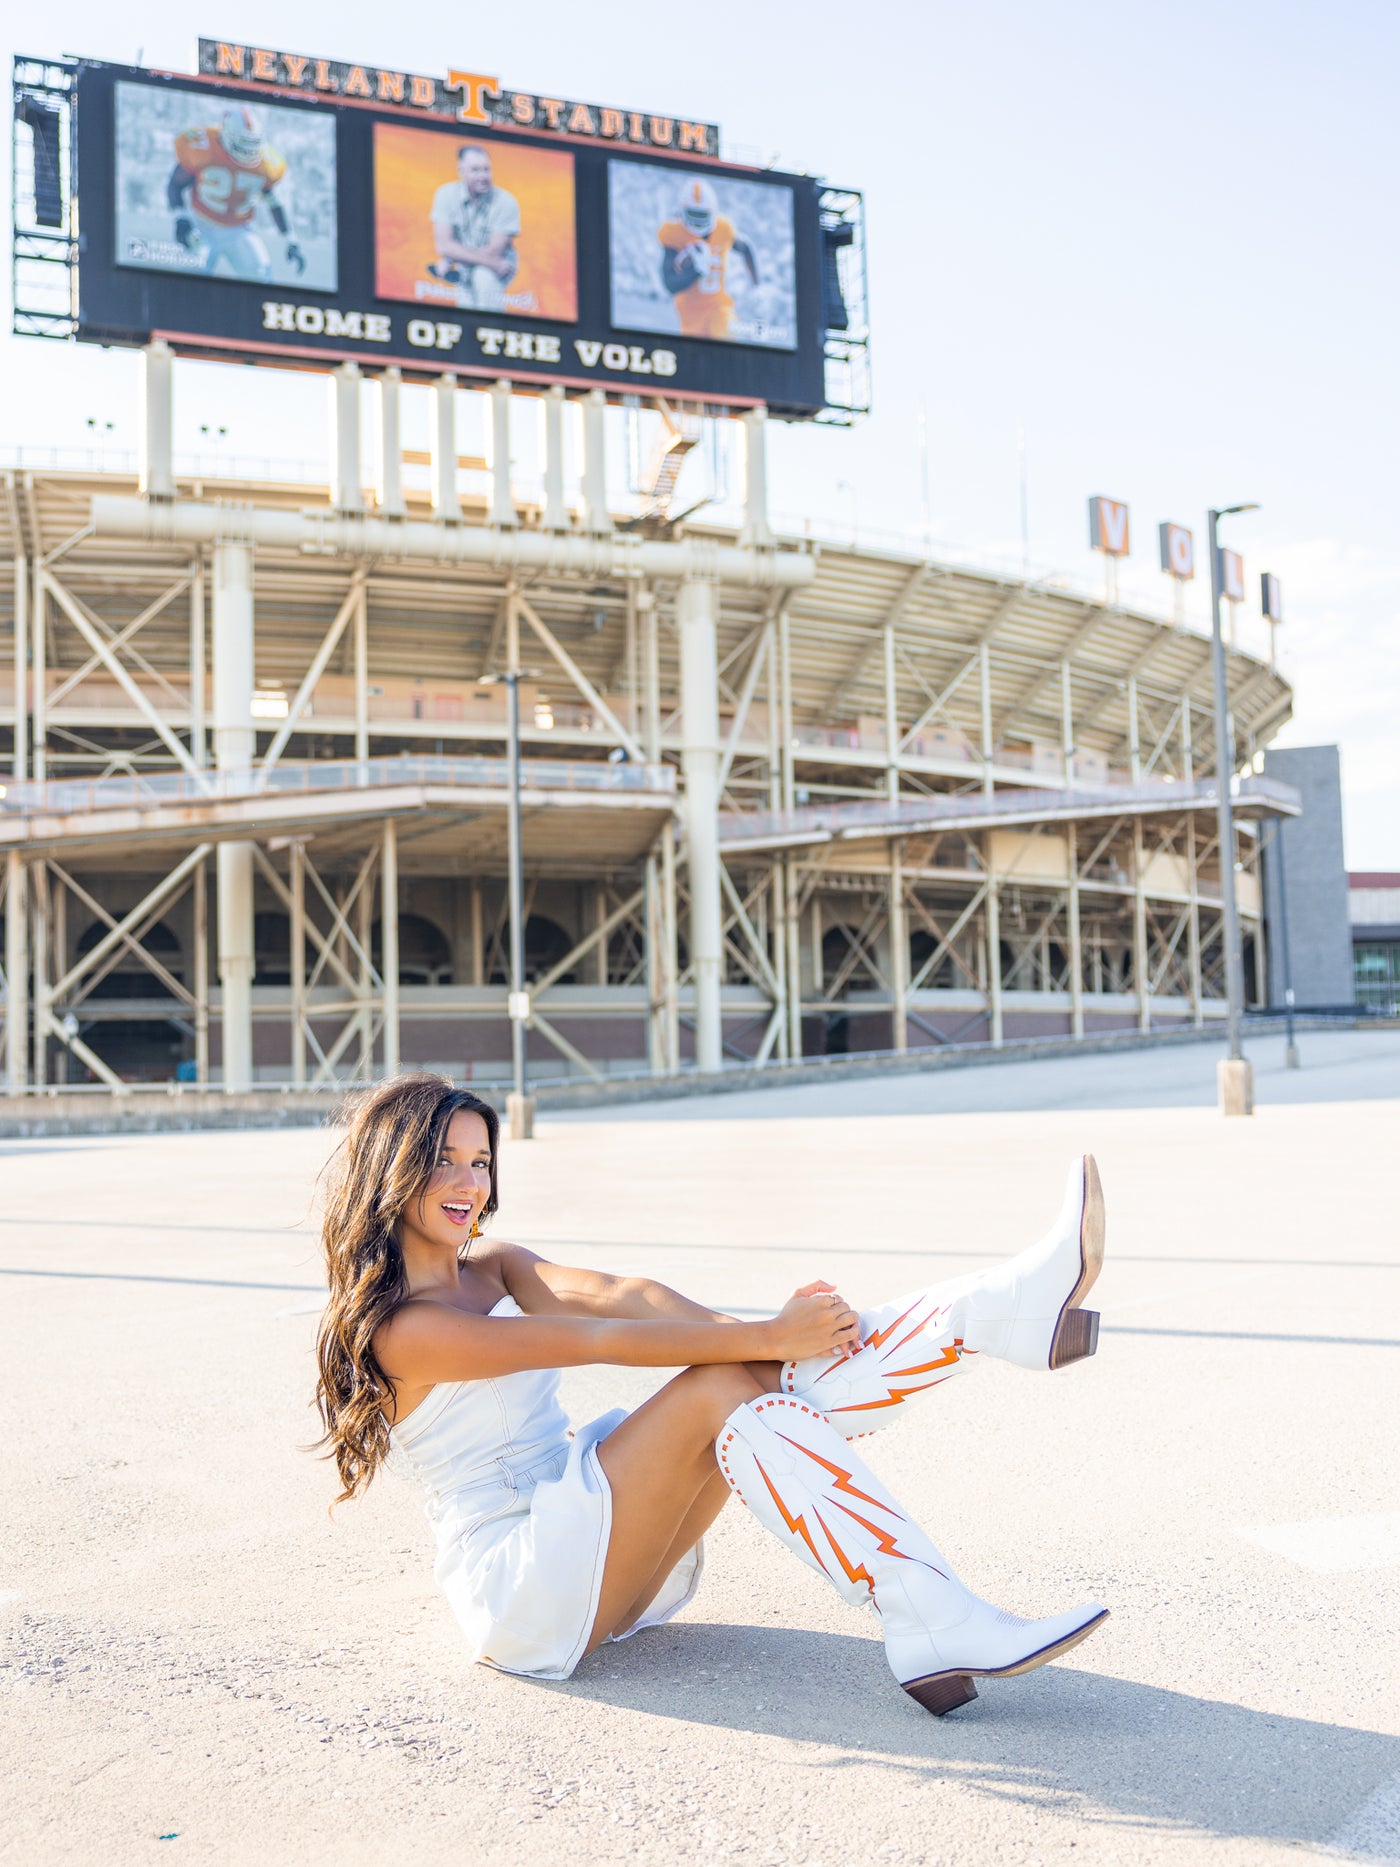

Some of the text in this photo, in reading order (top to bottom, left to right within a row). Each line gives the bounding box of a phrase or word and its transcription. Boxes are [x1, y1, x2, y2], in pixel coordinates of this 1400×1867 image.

[215, 41, 709, 151] NEYLAND T STADIUM
[262, 301, 677, 377] HOME OF THE VOLS
